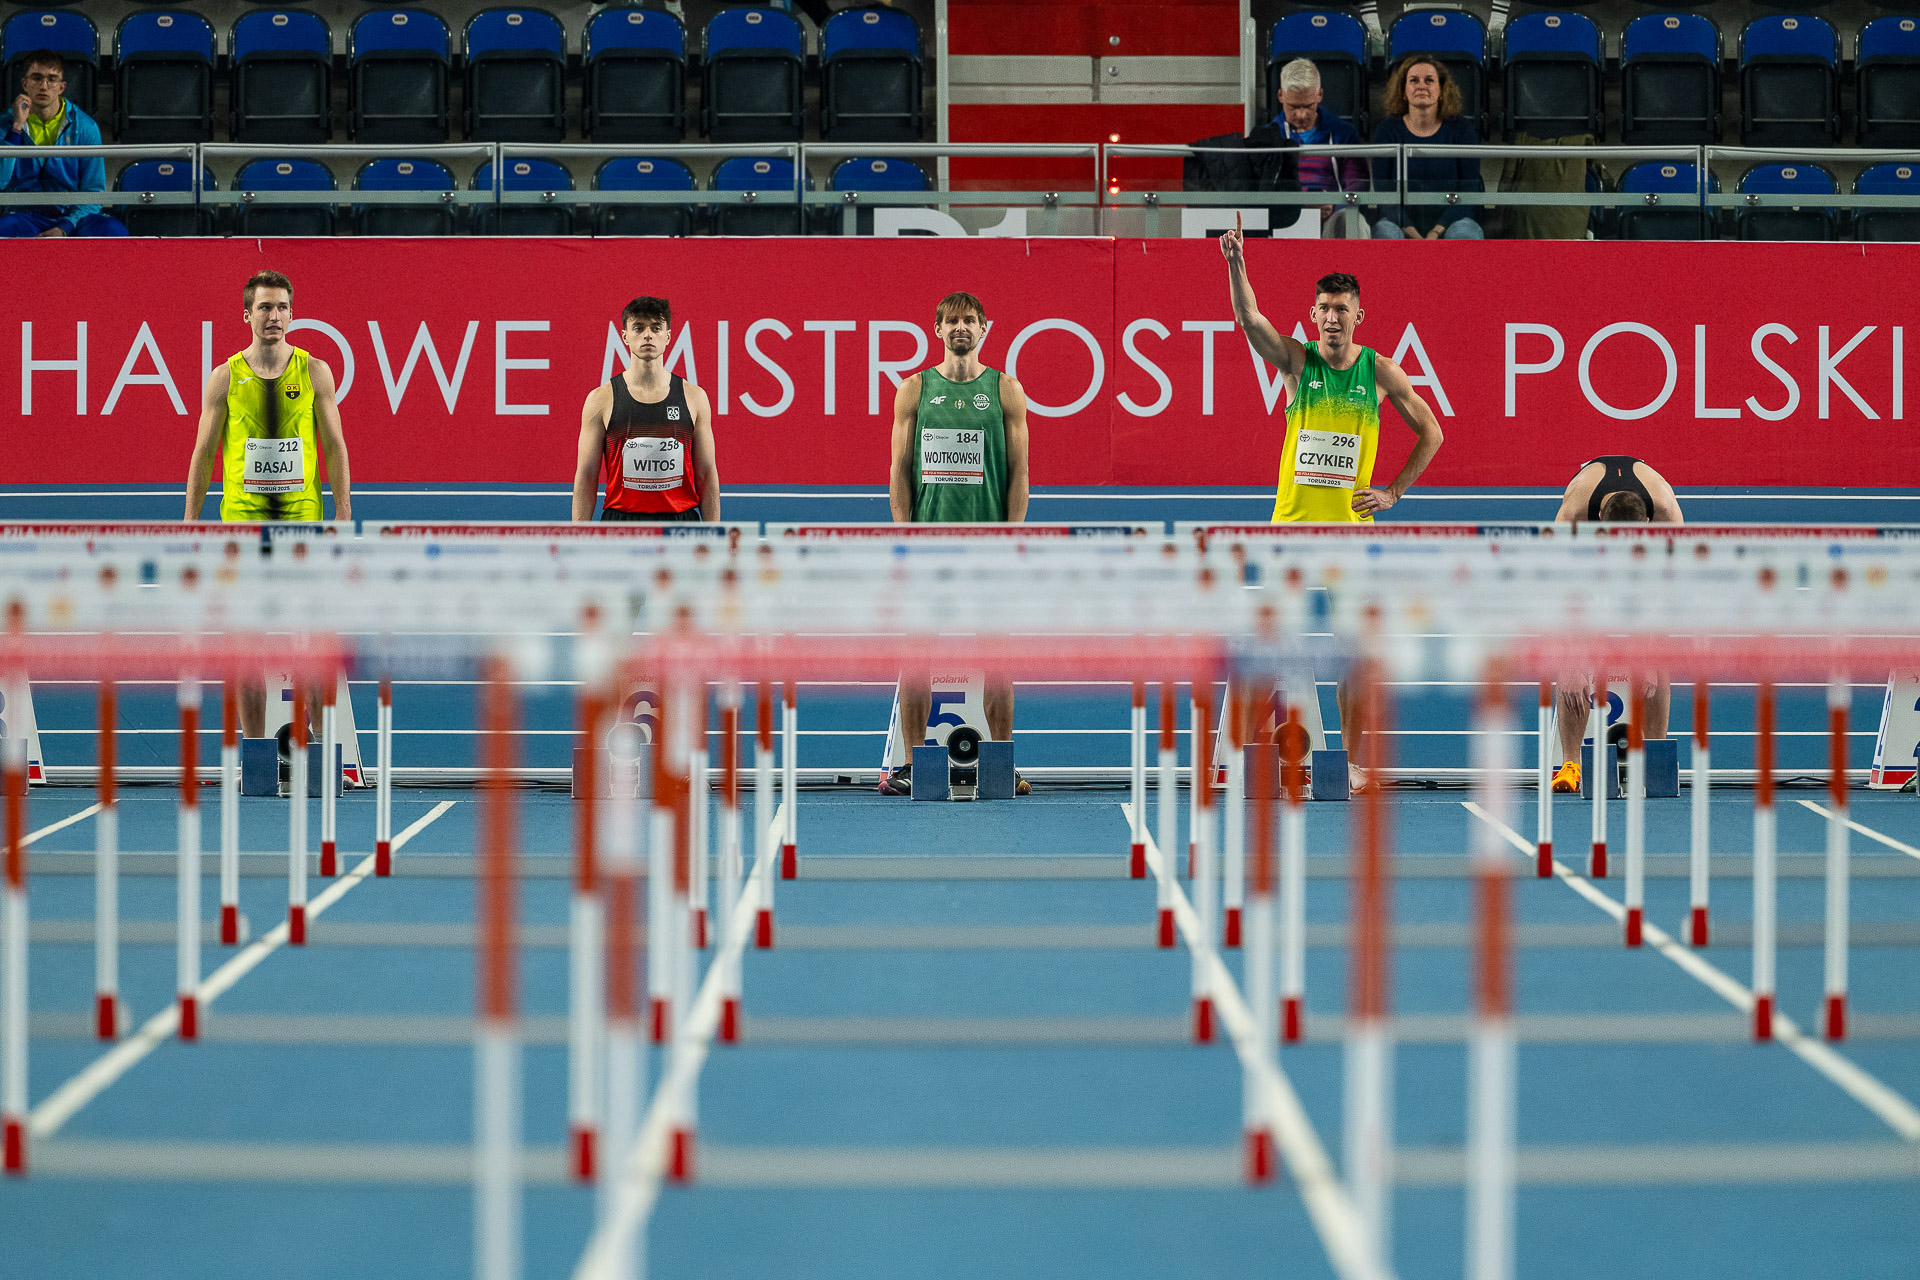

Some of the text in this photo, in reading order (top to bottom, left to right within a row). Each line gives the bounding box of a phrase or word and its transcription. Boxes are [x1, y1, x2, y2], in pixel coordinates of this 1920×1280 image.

[600, 318, 1455, 418] MISTROSTA
[1505, 321, 1904, 421] POLSKI
[930, 396, 947, 404] 4F
[956, 432, 979, 444] 184
[1332, 436, 1355, 448] 296
[278, 441, 298, 452] 212
[660, 440, 680, 452] 258
[924, 452, 980, 464] WOJTKOWSKI
[1300, 452, 1354, 470] CZYKIER
[254, 460, 294, 474] BASAJ
[634, 458, 676, 472] WITOS
[932, 674, 970, 685] polanik
